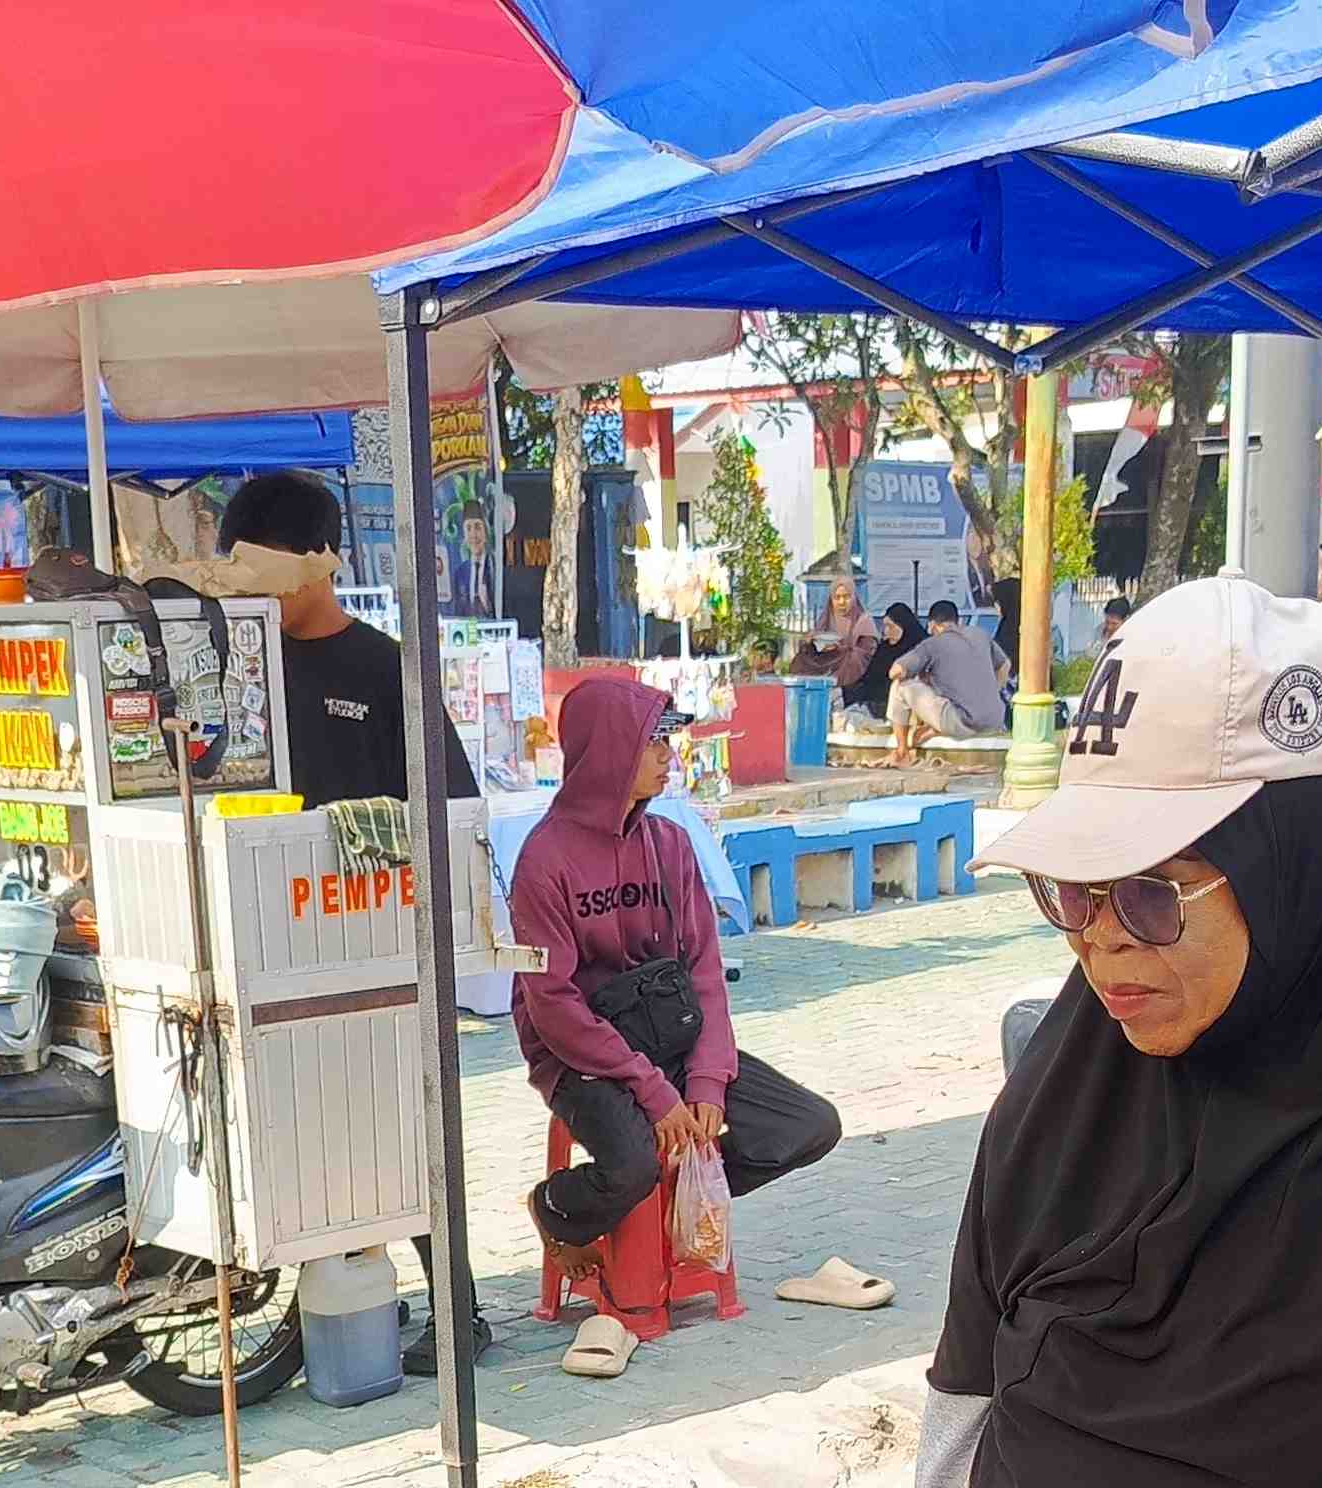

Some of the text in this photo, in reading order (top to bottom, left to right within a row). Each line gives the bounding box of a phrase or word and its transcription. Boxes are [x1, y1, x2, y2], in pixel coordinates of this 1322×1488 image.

[864, 471, 942, 504] SPMB
[1068, 638, 1139, 755] LA
[1285, 695, 1308, 726] LA
[291, 863, 416, 921] PEMPE
[24, 1215, 127, 1274] HOND
